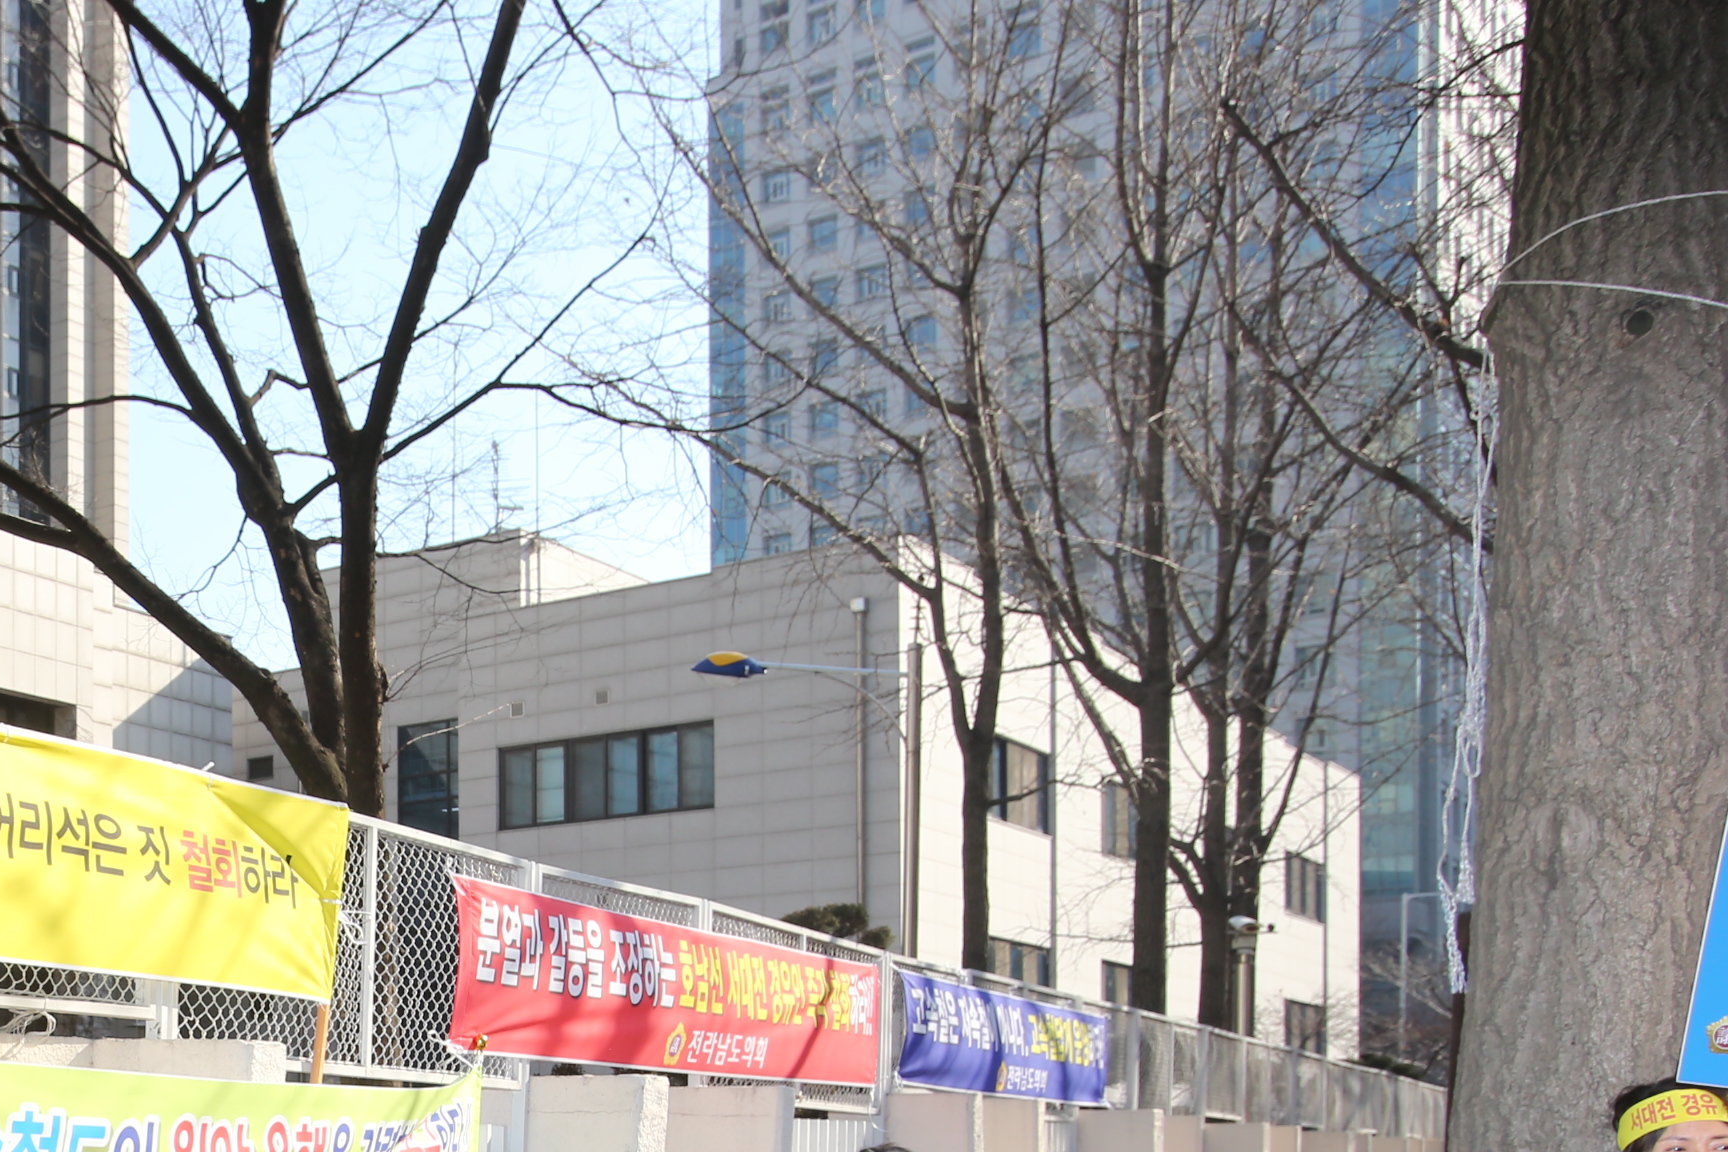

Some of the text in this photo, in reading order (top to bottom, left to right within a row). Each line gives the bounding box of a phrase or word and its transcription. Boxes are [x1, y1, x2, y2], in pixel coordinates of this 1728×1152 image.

[138, 824, 171, 886] 짓
[179, 828, 299, 910] 철회하라
[476, 898, 544, 990] 분열과
[548, 914, 605, 999] 갈등을
[609, 929, 676, 1008] 조장하는
[679, 939, 724, 1015] 호남선
[726, 950, 768, 1021] 서대전
[686, 1030, 769, 1069] 전라남도의회
[1631, 1093, 1718, 1131] 서대전 경유
